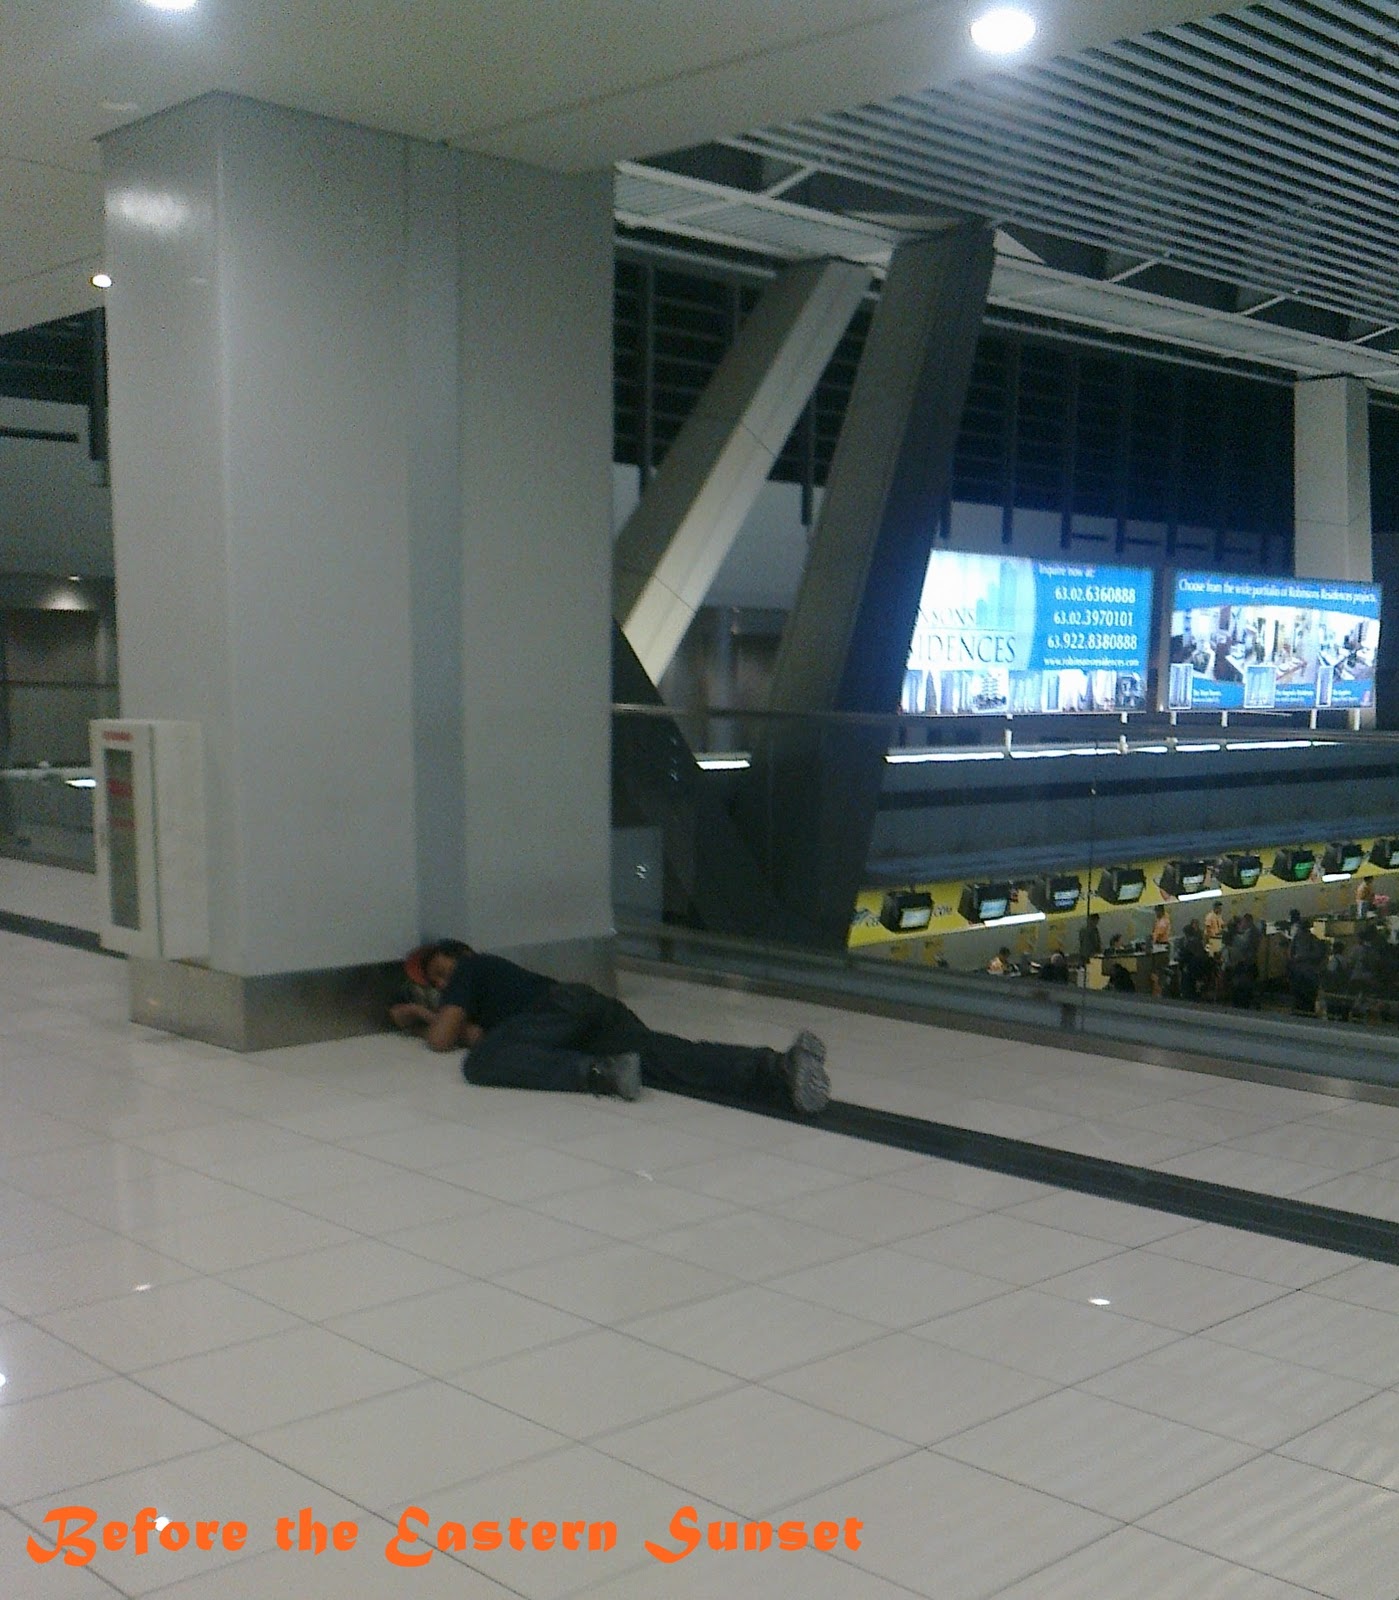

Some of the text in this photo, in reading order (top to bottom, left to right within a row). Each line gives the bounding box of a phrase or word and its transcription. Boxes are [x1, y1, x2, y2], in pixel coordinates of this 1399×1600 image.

[1054, 585, 1136, 604] 63.02.6360888
[1178, 578, 1206, 593] Choose
[1206, 582, 1221, 593] from
[1223, 581, 1234, 594] the
[1234, 583, 1252, 595] wide
[1320, 588, 1353, 601] Residences
[1053, 609, 1134, 627] 63.02.3970101
[909, 634, 1016, 663] IDENCES
[1047, 632, 1138, 650] 63.922.8380888
